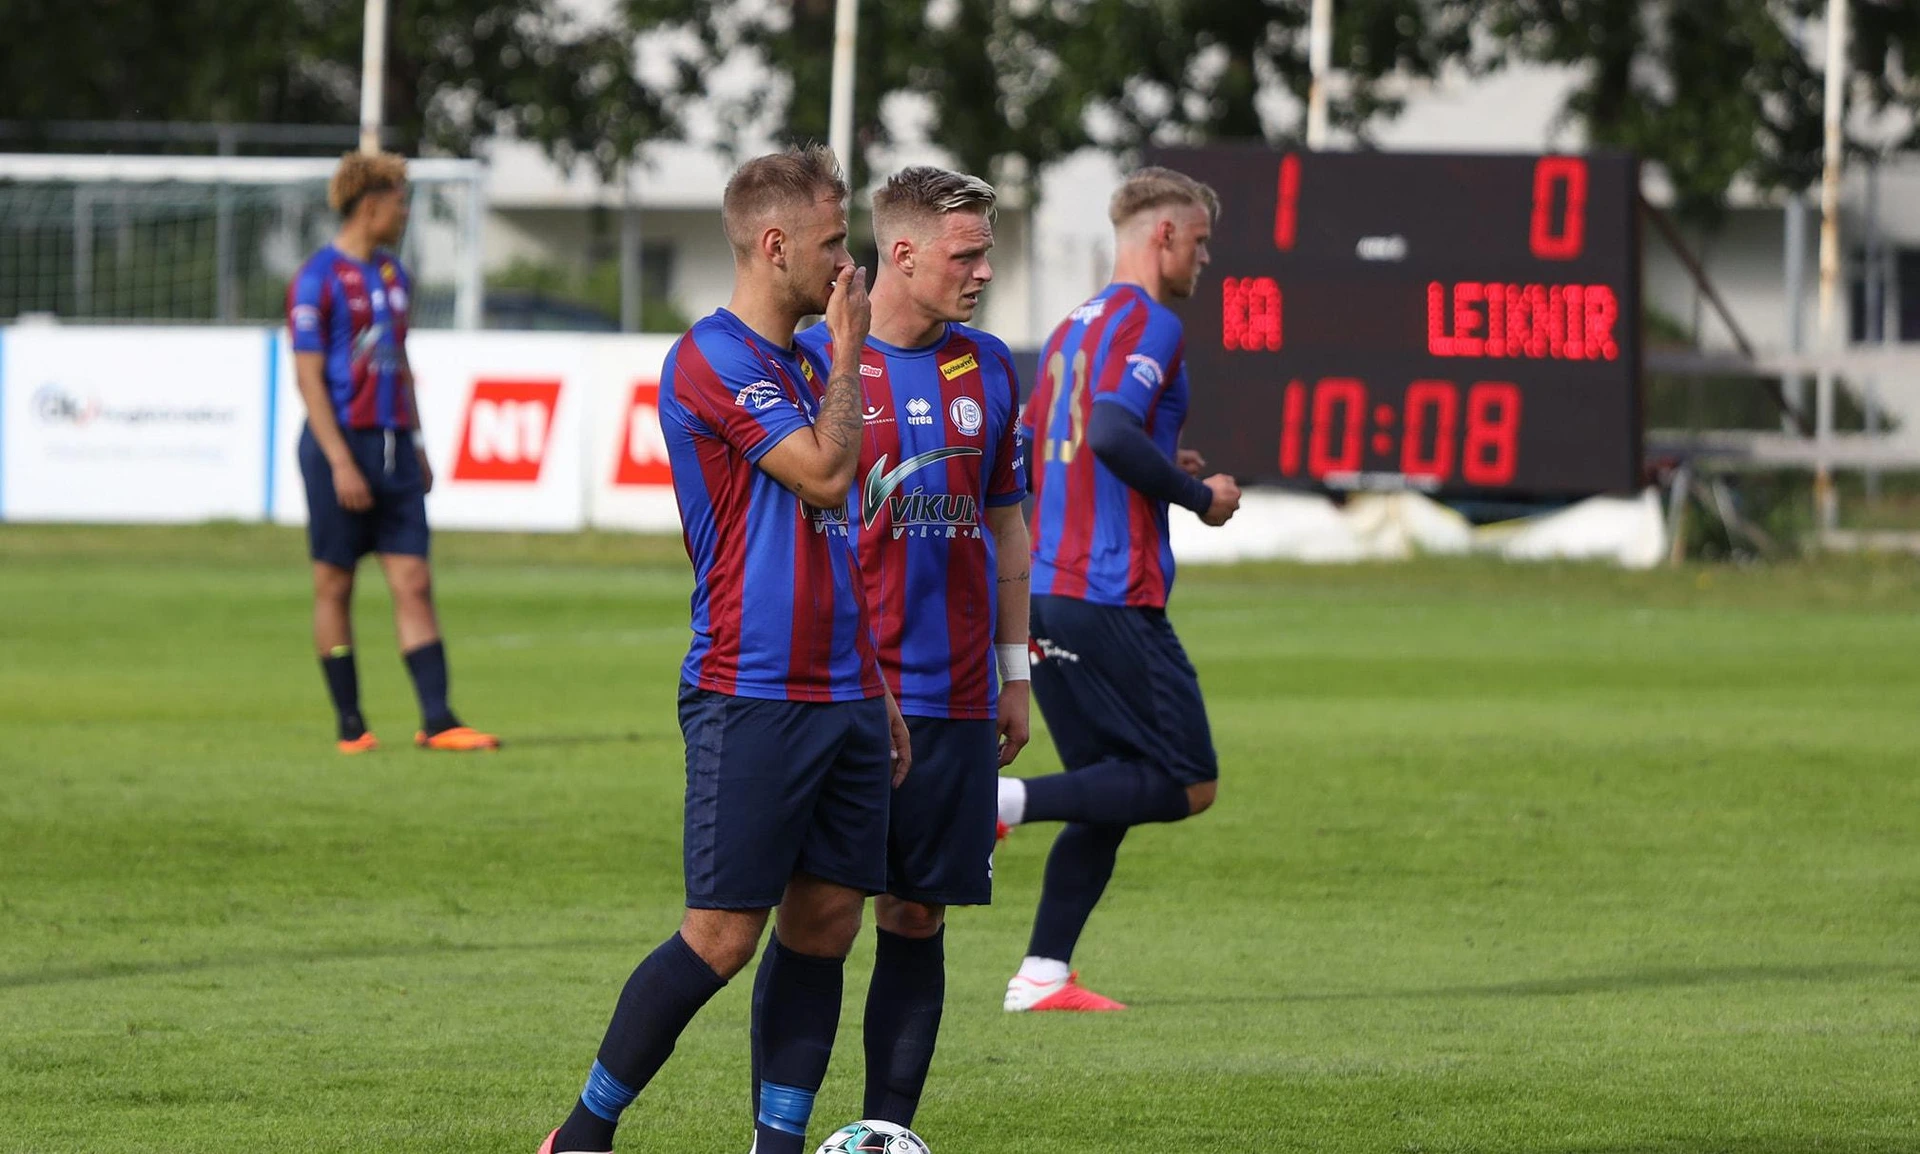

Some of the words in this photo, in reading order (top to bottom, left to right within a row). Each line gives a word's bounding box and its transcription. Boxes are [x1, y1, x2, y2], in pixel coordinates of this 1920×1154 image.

[1274, 152, 1301, 253] 1
[1529, 154, 1589, 261] 0
[1222, 276, 1283, 352] KA
[1427, 280, 1618, 360] LEIKNIR
[469, 399, 548, 463] N1
[628, 403, 668, 467] N
[1043, 348, 1087, 464] 23
[1280, 376, 1522, 487] 10:08
